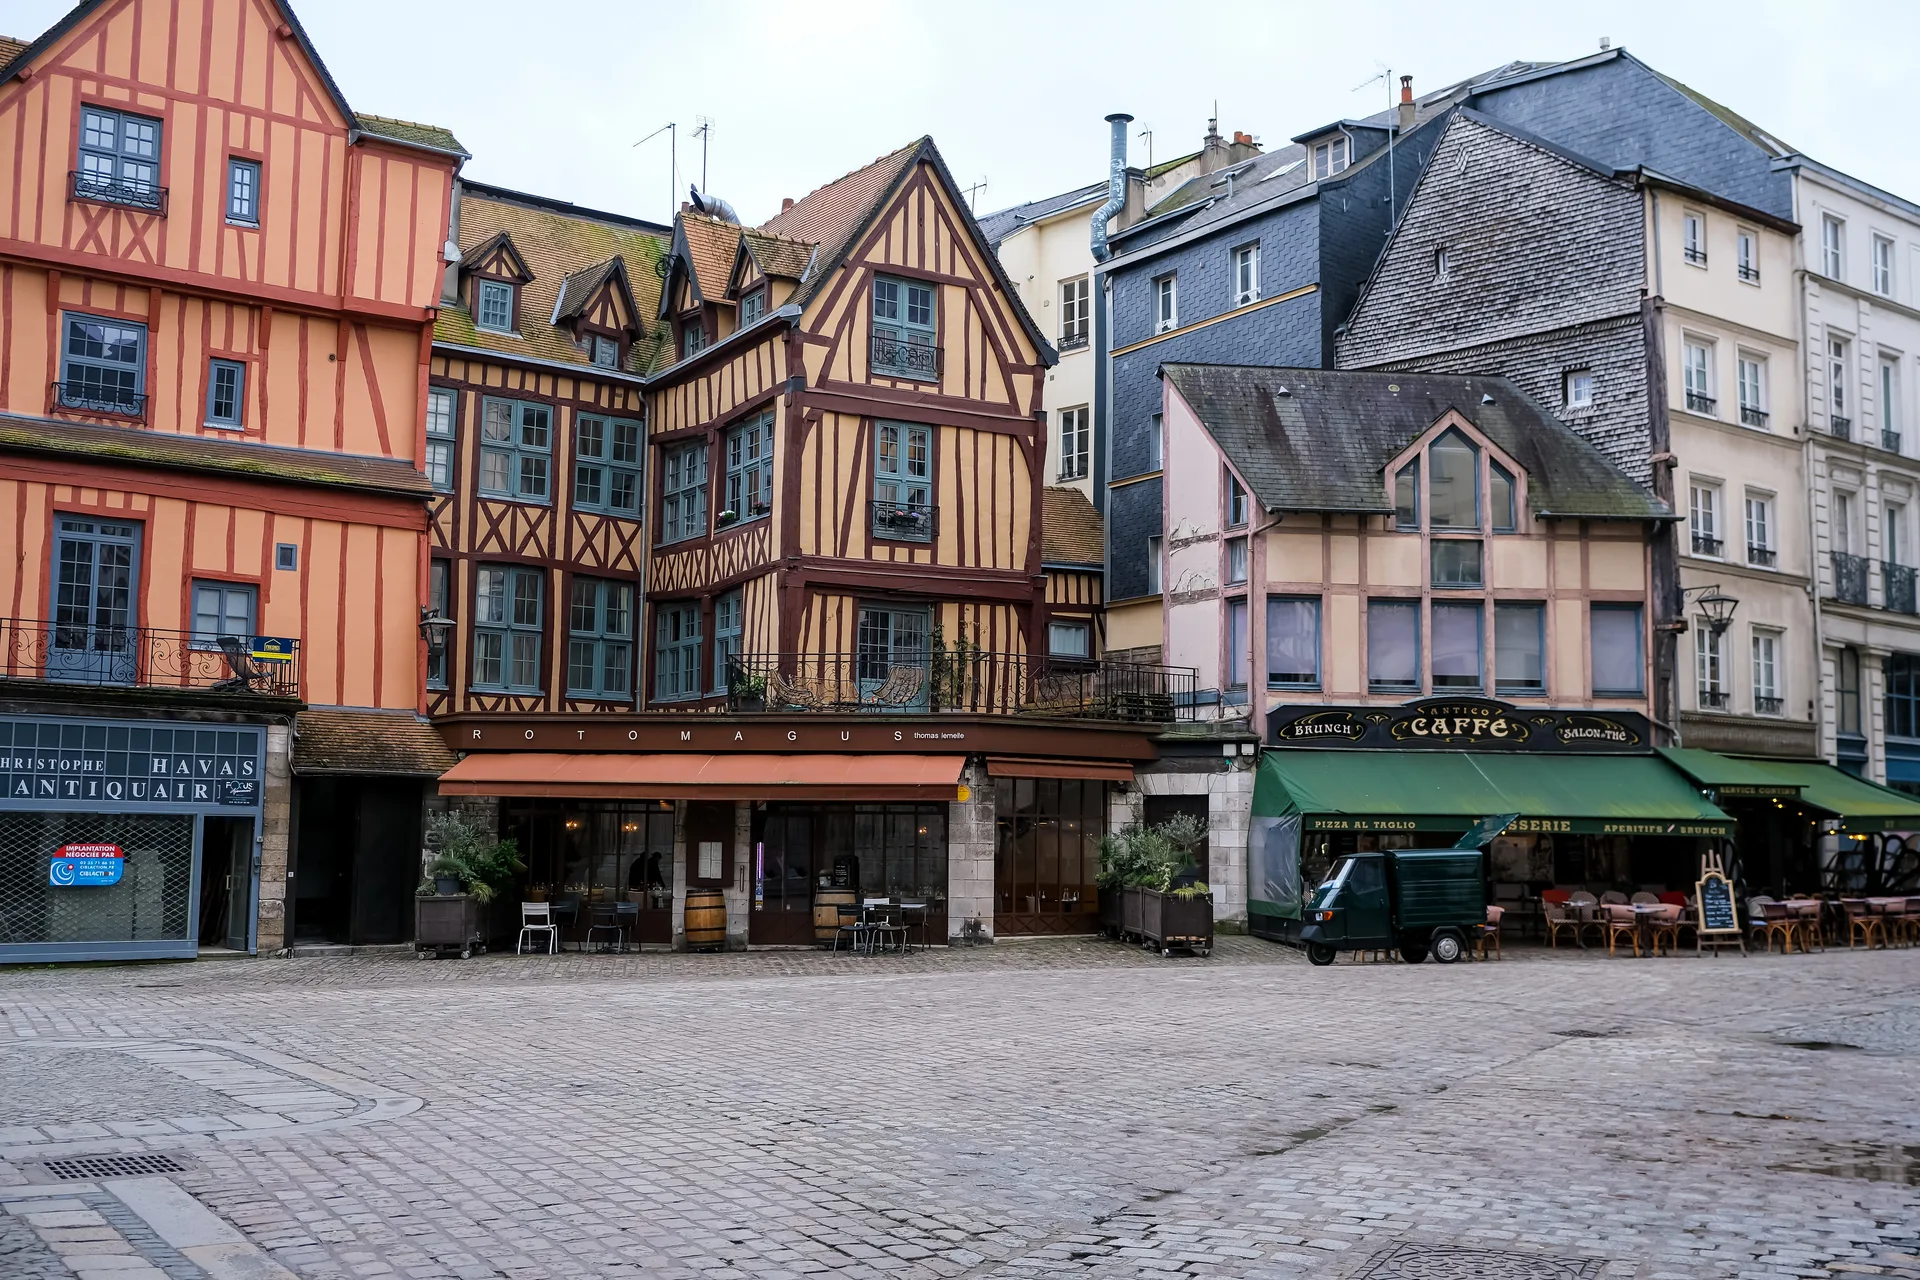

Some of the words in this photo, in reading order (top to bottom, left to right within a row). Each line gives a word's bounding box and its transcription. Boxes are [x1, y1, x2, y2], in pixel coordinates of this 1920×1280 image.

[1430, 706, 1489, 716] ANTICO
[914, 731, 939, 739] thomas
[1294, 723, 1351, 736] BRUNCH
[1563, 727, 1601, 739] SALON
[0, 757, 104, 772] HRISTOPHE
[152, 758, 254, 776] HAVAS
[14, 779, 221, 800] ANTIQUAIR
[1720, 786, 1756, 794] SERVICE
[1315, 820, 1348, 829] PIZZA
[1354, 821, 1368, 829] AL
[1374, 821, 1416, 829] TAGLIO
[1604, 824, 1663, 833] APERITIFS
[1680, 826, 1726, 835] BRUNCH
